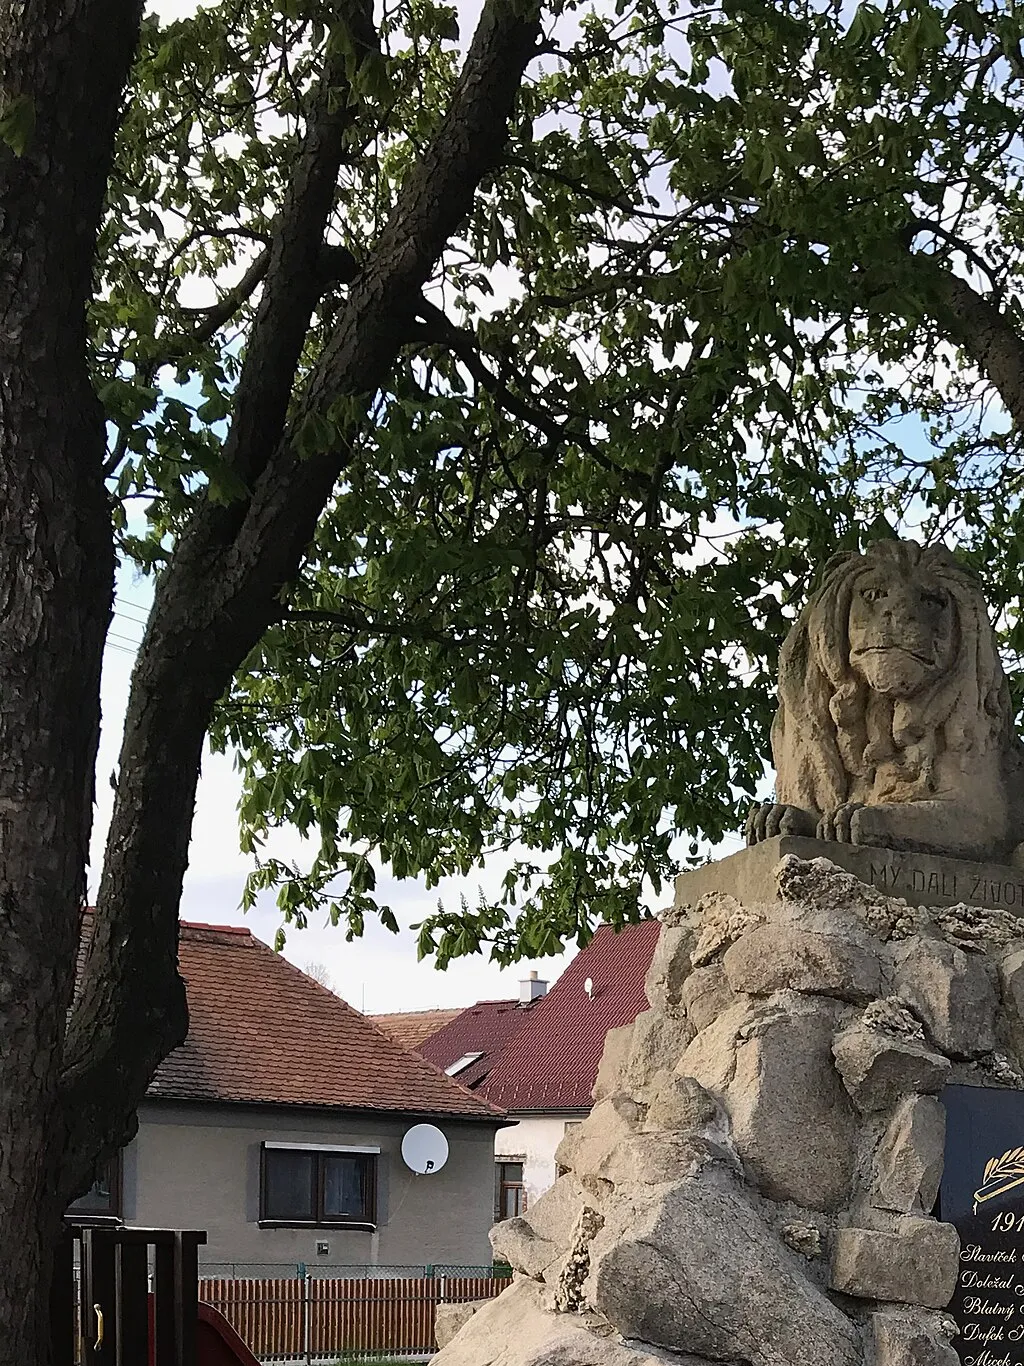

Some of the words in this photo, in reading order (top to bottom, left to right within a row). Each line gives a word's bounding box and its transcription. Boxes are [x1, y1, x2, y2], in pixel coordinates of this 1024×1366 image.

[870, 862, 900, 887] MY
[912, 869, 957, 897] DALI
[960, 1270, 1014, 1290] Doležal
[962, 1296, 1015, 1321] Blatný
[962, 1323, 1004, 1347] Dufek
